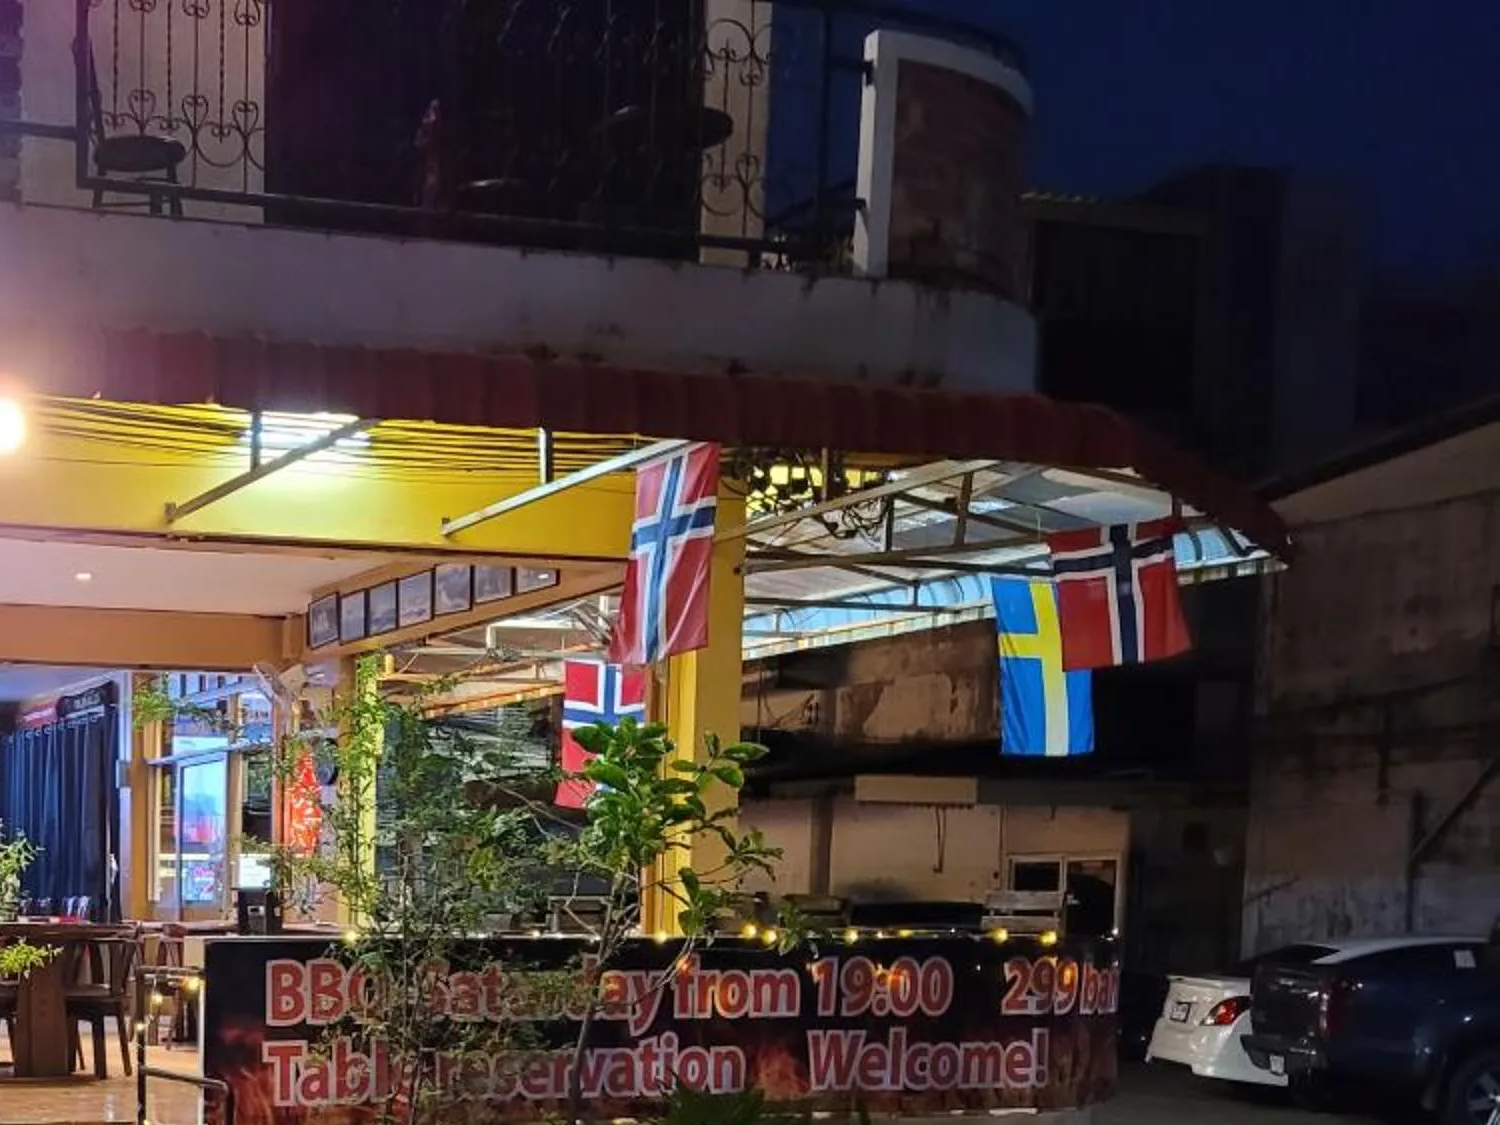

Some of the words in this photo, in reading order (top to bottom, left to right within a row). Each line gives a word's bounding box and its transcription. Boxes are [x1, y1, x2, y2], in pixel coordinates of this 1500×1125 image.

[672, 953, 800, 1020] from
[813, 956, 954, 1017] 19:00
[1001, 956, 1079, 1015] 299
[807, 1028, 1050, 1092] Welcome!
